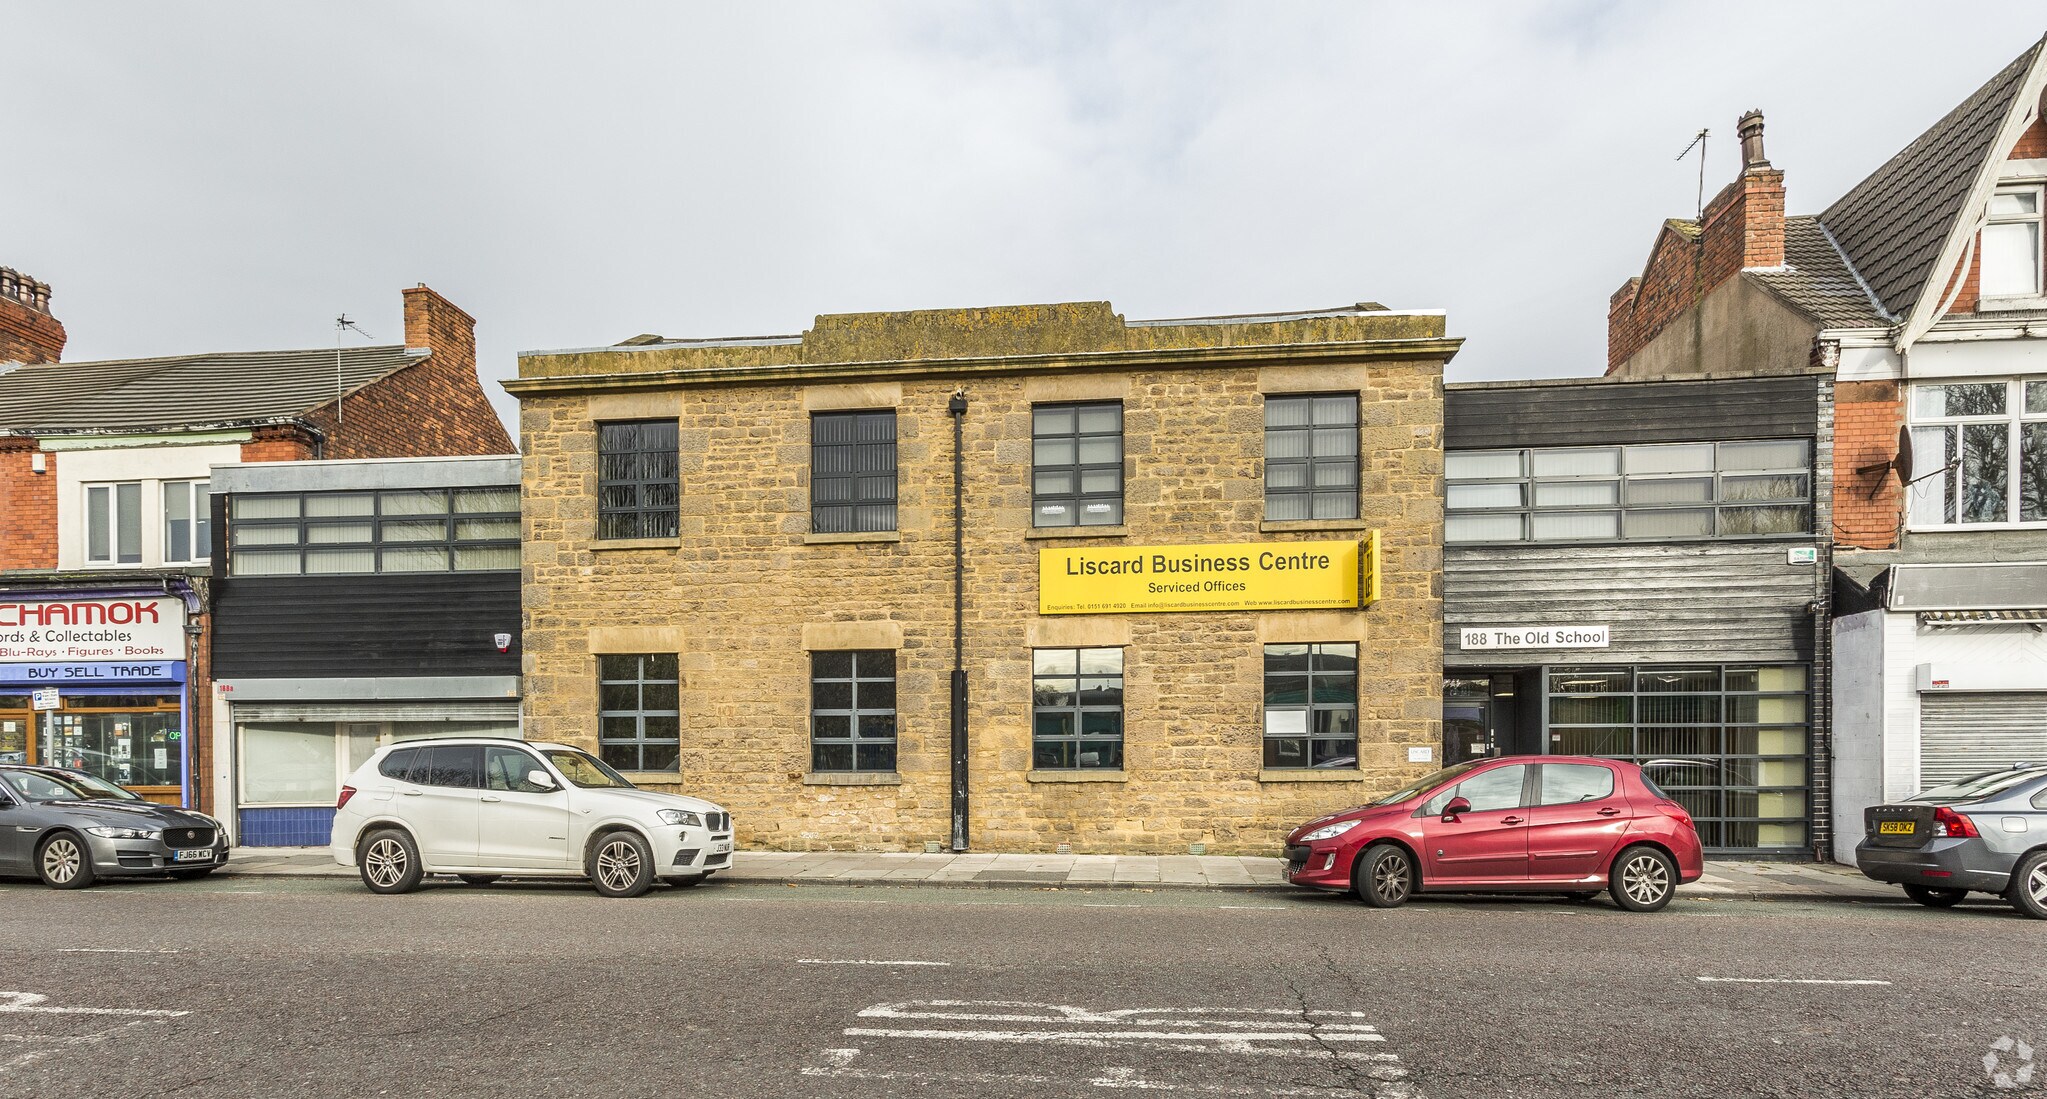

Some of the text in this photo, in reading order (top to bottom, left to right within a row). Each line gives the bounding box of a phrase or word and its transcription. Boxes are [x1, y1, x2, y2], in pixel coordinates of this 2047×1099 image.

[1066, 551, 1330, 576] Liscard Business Centre
[1148, 580, 1246, 593] Serviced Offices
[1102, 602, 1112, 610] 691
[1258, 598, 1351, 606] www.liscardbusinesscentre.com
[29, 630, 41, 643] &
[45, 629, 132, 643] Collectables
[1465, 630, 1605, 645] 188 The Old School
[0, 646, 164, 658] Blu-Rays Figures Books
[28, 665, 162, 678] BUY SELL TRADE
